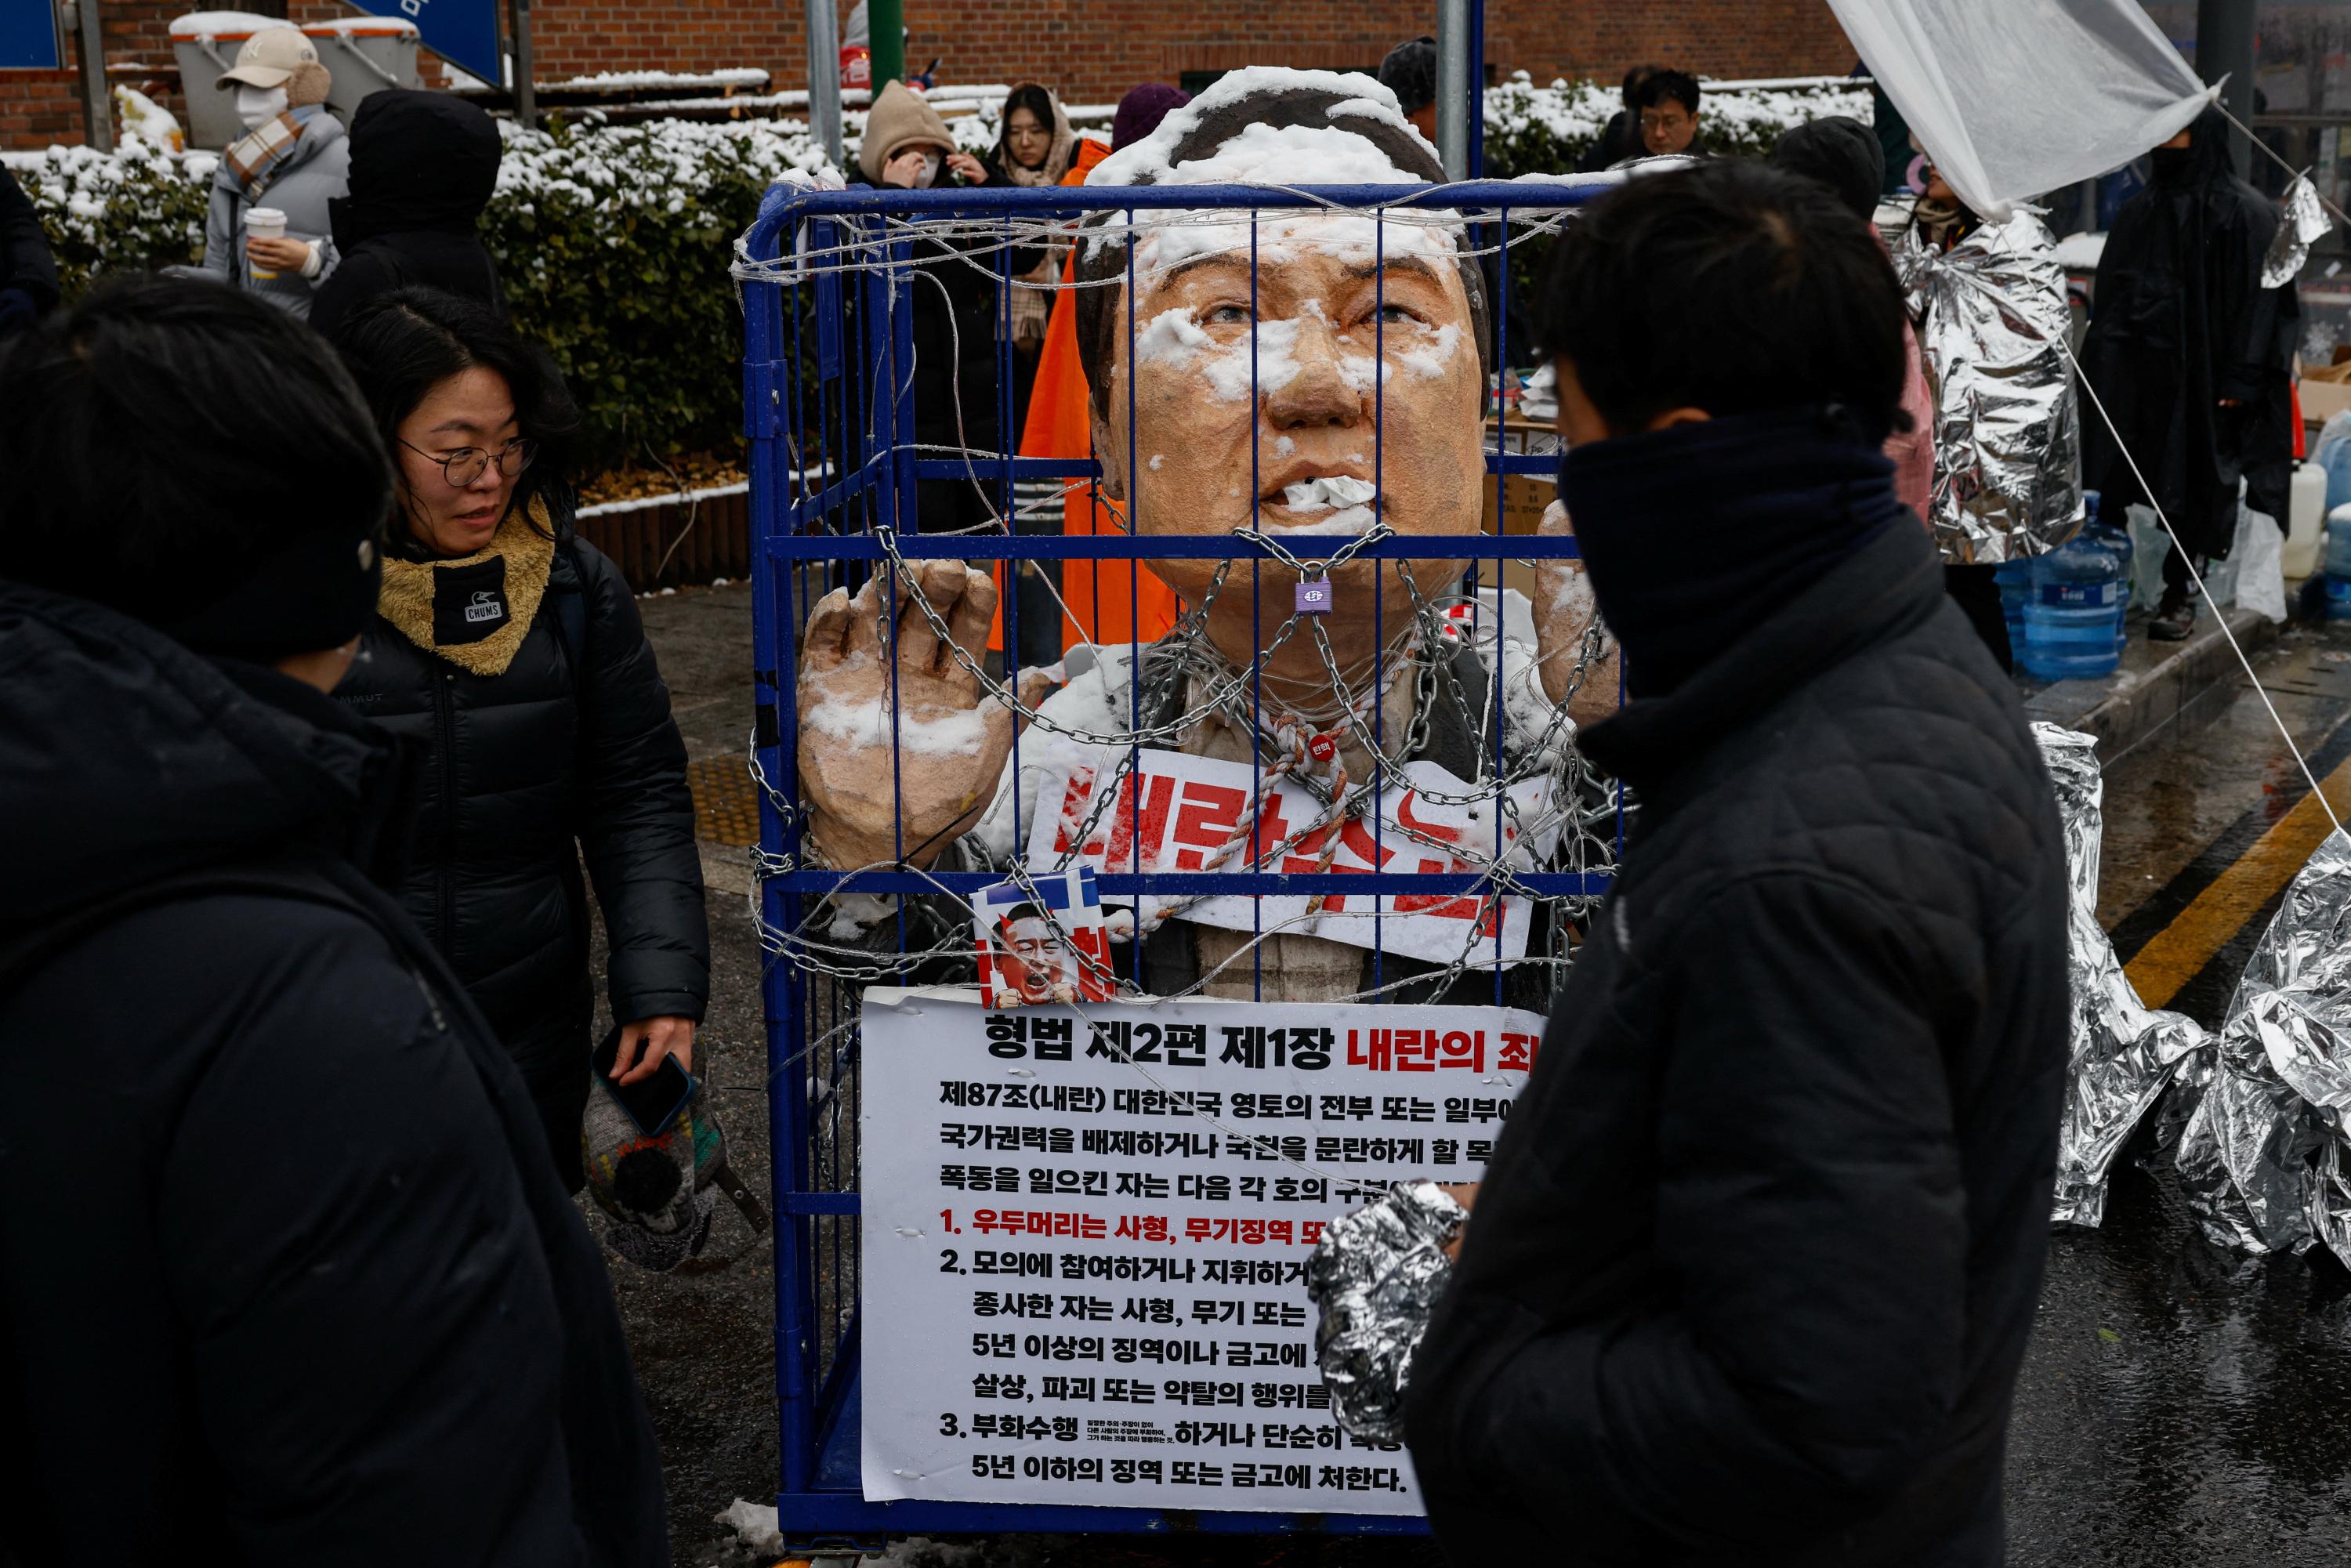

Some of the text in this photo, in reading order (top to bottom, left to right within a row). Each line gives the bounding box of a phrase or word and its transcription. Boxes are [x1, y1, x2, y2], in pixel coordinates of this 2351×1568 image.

[468, 605, 498, 619] CHUMS
[339, 693, 383, 704] MMUT
[1312, 741, 1331, 755] 탄핵
[985, 1014, 1539, 1077] 형법 제2편 제1장 내란의 죄
[940, 1081, 1106, 1113] 제87조(내란)
[1114, 1089, 1222, 1117] 대한민국
[1231, 1093, 1312, 1120] 영토의
[1320, 1095, 1373, 1121] 전부
[1382, 1097, 1435, 1122] 또는
[940, 1123, 1074, 1153] 국가권력을
[1082, 1130, 1219, 1158] 배제하거나
[1315, 1137, 1423, 1164] 문란하게
[1432, 1139, 1458, 1164] 할
[1466, 1140, 1494, 1165] 목
[940, 1165, 1400, 1204] 폭동을 일으킨 자는 다음 각 호의 구분
[940, 1209, 1326, 1245] 1. 우두머리는 사형, 무기징역 또
[940, 1249, 1310, 1287] 2. 모의에 참여하거나 지휘하거
[973, 1291, 1306, 1327] 종사한 자는 사형, 무기 또는
[973, 1334, 1306, 1367] 5년 이상의 징역이나 금고에
[972, 1374, 1330, 1409] 살상, 파괴 또는 약탈의 행위를
[940, 1413, 966, 1438] 3.
[973, 1414, 1078, 1441] 부화수행
[1175, 1421, 1255, 1447] 하거나
[1262, 1423, 1342, 1450] 단순히
[973, 1455, 1407, 1493] 5년 이하의 징역 또는 금고에 처한다.
